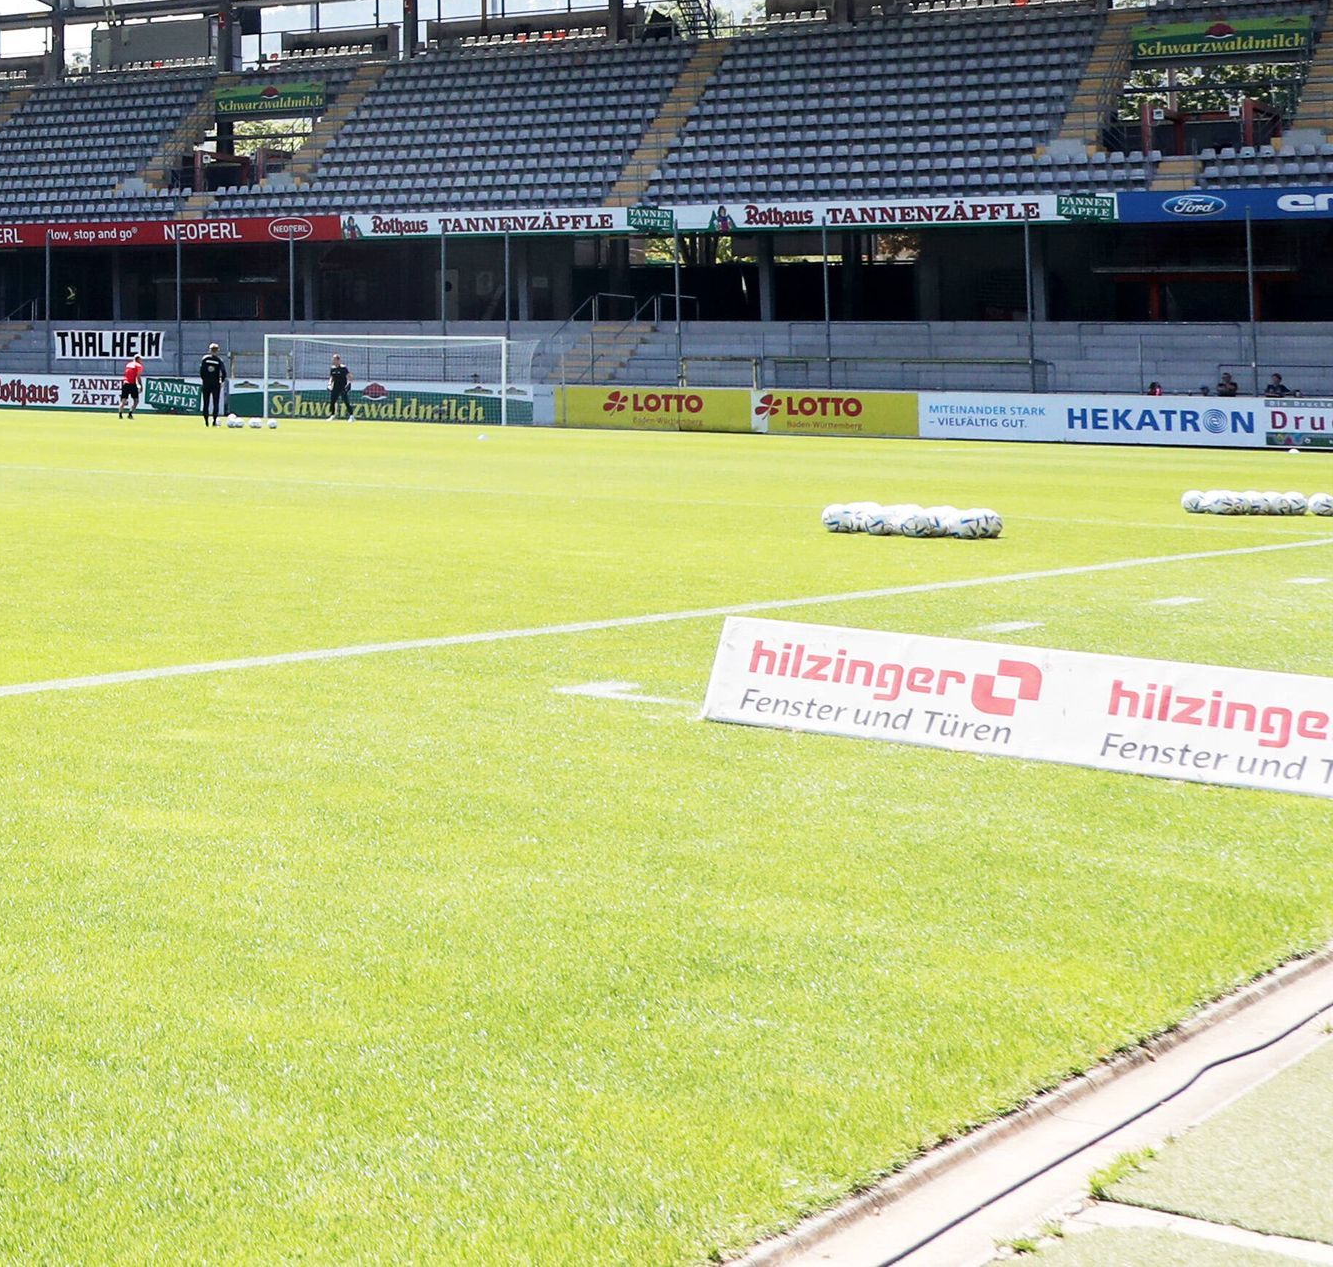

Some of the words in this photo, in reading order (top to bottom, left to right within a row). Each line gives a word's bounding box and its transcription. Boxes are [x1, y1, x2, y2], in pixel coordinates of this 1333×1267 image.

[1137, 34, 1306, 56] Schwarzwaldmilch
[218, 95, 323, 112] Schwarzwaldmilch
[1059, 196, 1111, 207] TANNEN
[1173, 196, 1215, 213] Ford
[629, 208, 671, 219] TANNEN
[744, 205, 813, 228] Rothaus
[826, 201, 1040, 224] TANNENZÄPFLE
[1061, 205, 1110, 217] ZÄPFLE
[371, 216, 428, 236] Rothaus
[438, 212, 613, 232] TANNENZÄPFLE
[630, 216, 671, 227] ZÄPFLE
[73, 229, 96, 242] stop
[98, 227, 117, 239] and
[164, 223, 242, 240] NEOPERL
[56, 332, 161, 357] THALHEIM
[70, 378, 125, 391] TANNE
[148, 381, 200, 396] TANNEN
[149, 392, 197, 408] ZÄPFLE
[633, 393, 703, 413] LOTTO
[786, 396, 862, 417] LOTTO
[929, 405, 1006, 416] MITEINANDER
[1010, 406, 1046, 416] STARK
[938, 415, 999, 428] VIELFÄLTIG
[1001, 417, 1027, 429] GUT.
[1067, 408, 1255, 433] HEKATRON
[1271, 411, 1333, 430] Dru
[749, 640, 965, 701] hilzinger
[739, 688, 848, 723] Fenster
[854, 707, 913, 731] und
[924, 710, 1012, 745] Türen
[1108, 679, 1333, 748] hilzinge
[1100, 732, 1229, 770] Fenster
[1237, 755, 1308, 781] und
